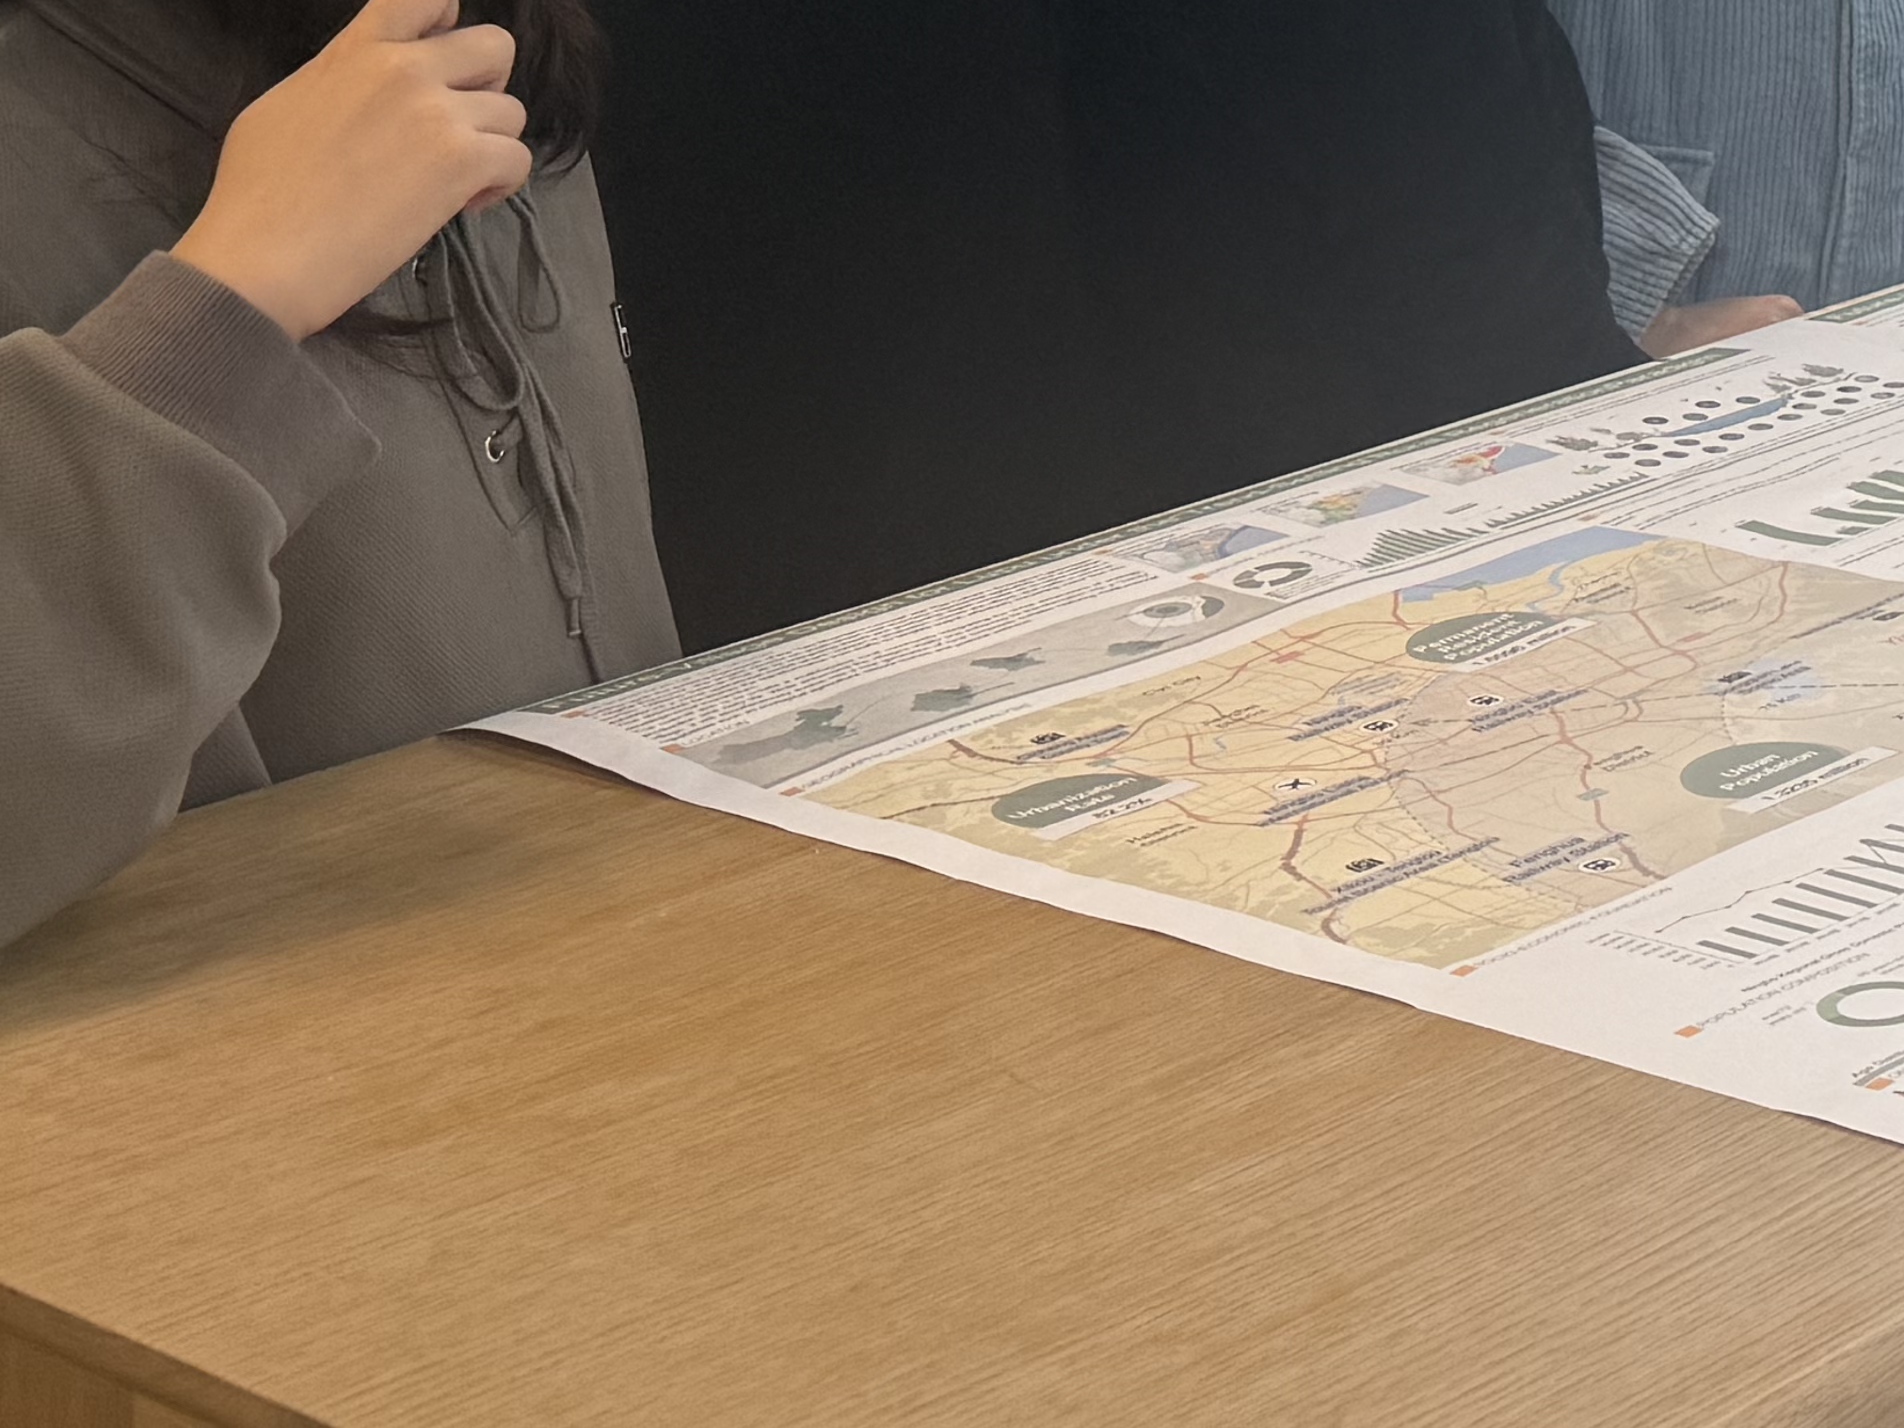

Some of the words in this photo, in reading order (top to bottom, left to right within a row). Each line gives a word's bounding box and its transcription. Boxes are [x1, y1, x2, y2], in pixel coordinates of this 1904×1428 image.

[1439, 620, 1549, 660] Population
[1715, 749, 1824, 791] Population
[1717, 752, 1784, 778] Urban
[1006, 774, 1140, 821] Urbanization
